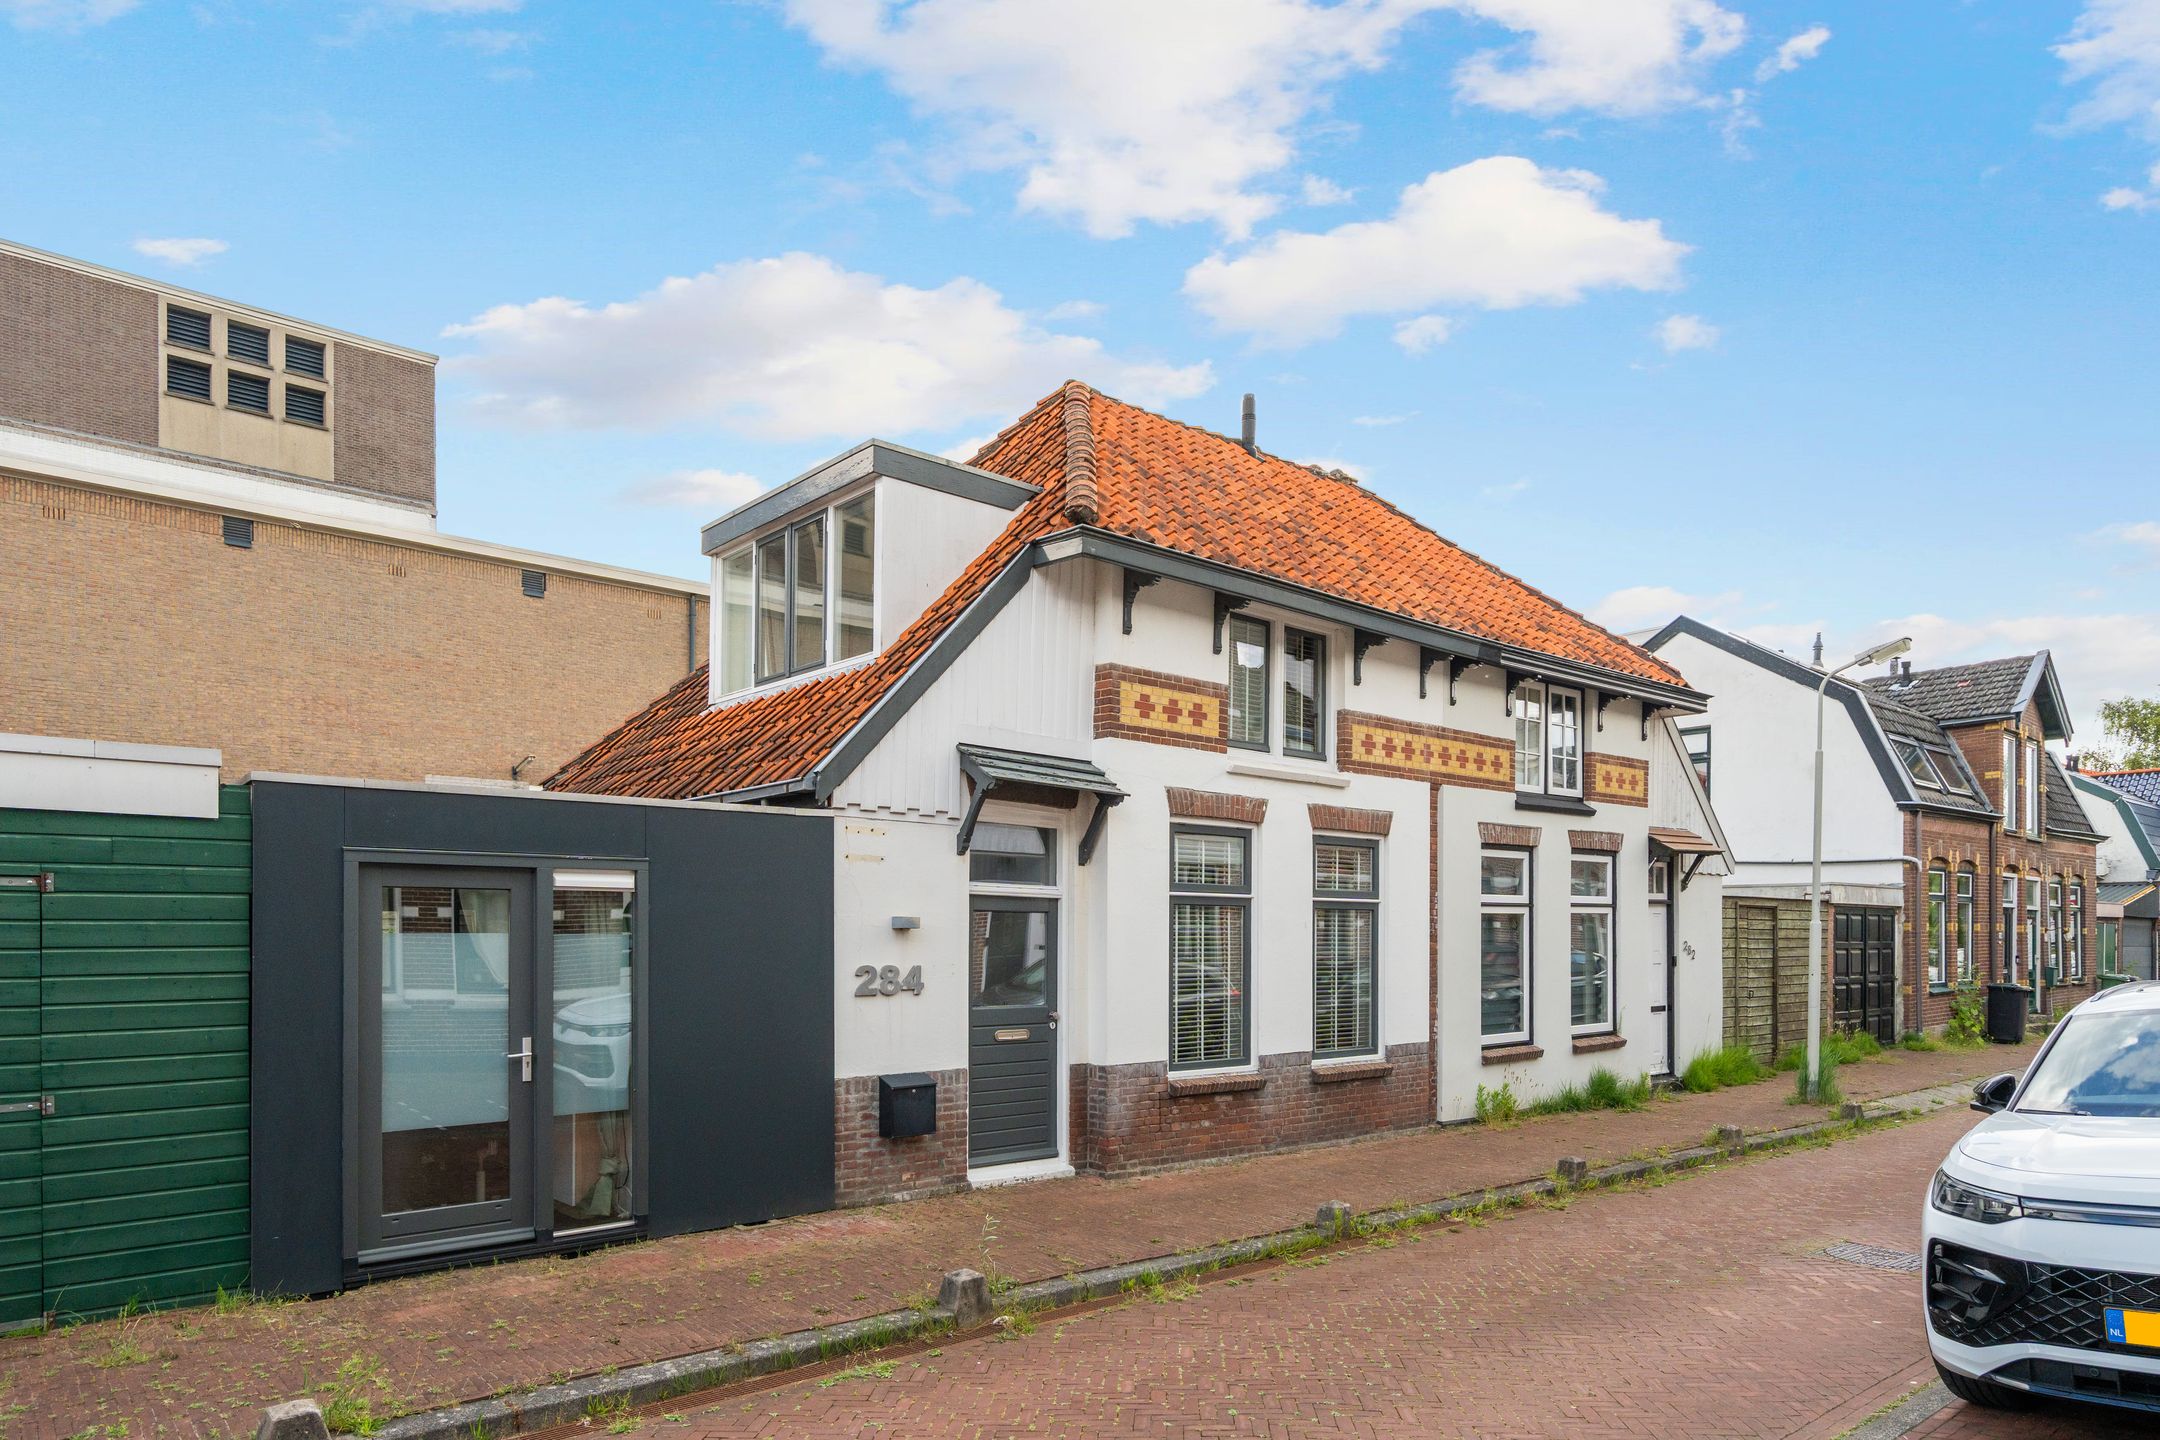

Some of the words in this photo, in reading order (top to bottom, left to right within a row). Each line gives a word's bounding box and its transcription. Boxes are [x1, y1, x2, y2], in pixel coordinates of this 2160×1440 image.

[1682, 940, 1696, 960] 282
[854, 964, 925, 997] 284
[2110, 1328, 2124, 1337] NL
